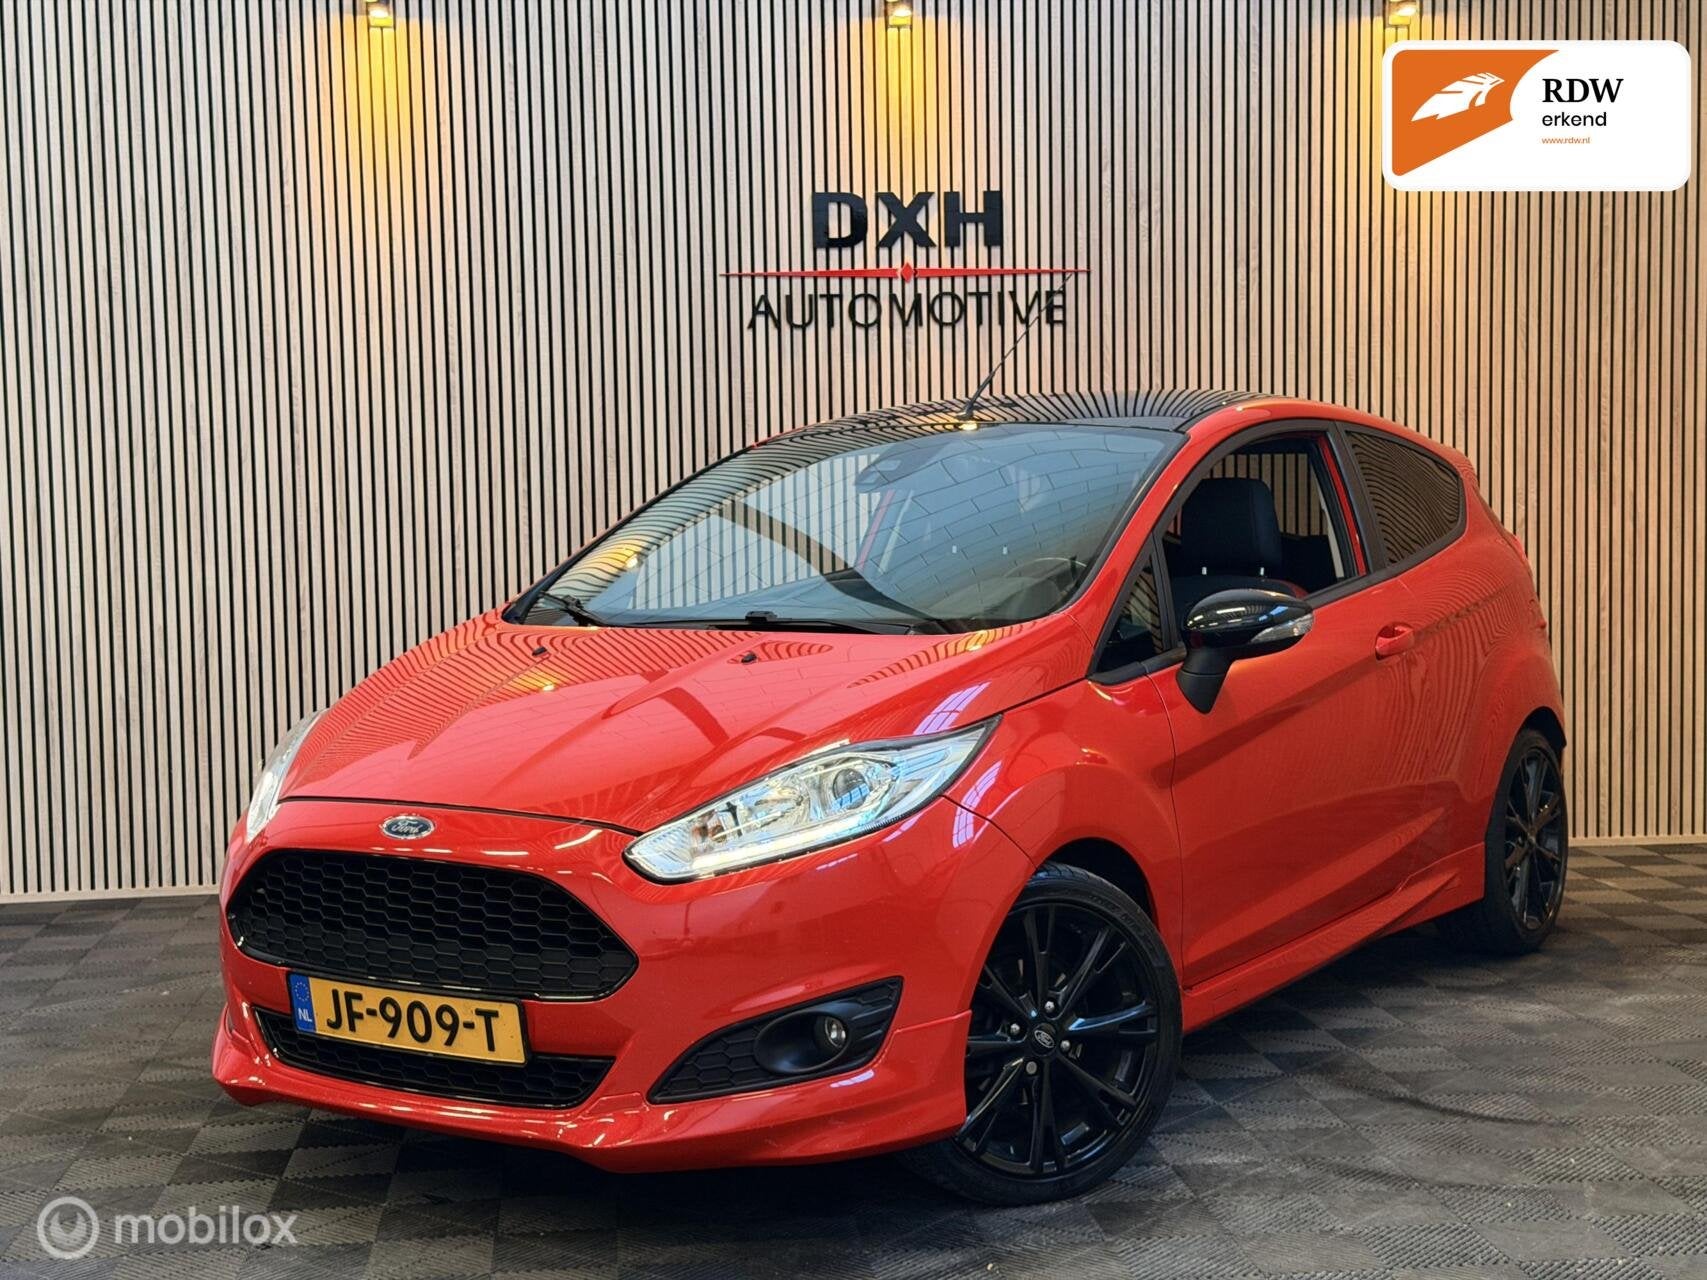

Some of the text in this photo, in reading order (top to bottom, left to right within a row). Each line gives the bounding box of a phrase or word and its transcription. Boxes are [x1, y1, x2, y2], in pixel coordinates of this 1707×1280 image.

[811, 190, 1003, 249] DXH
[747, 291, 1067, 329] AUTOMOTIVE
[391, 819, 424, 834] Ford
[298, 988, 500, 1052] NL JF-909-T
